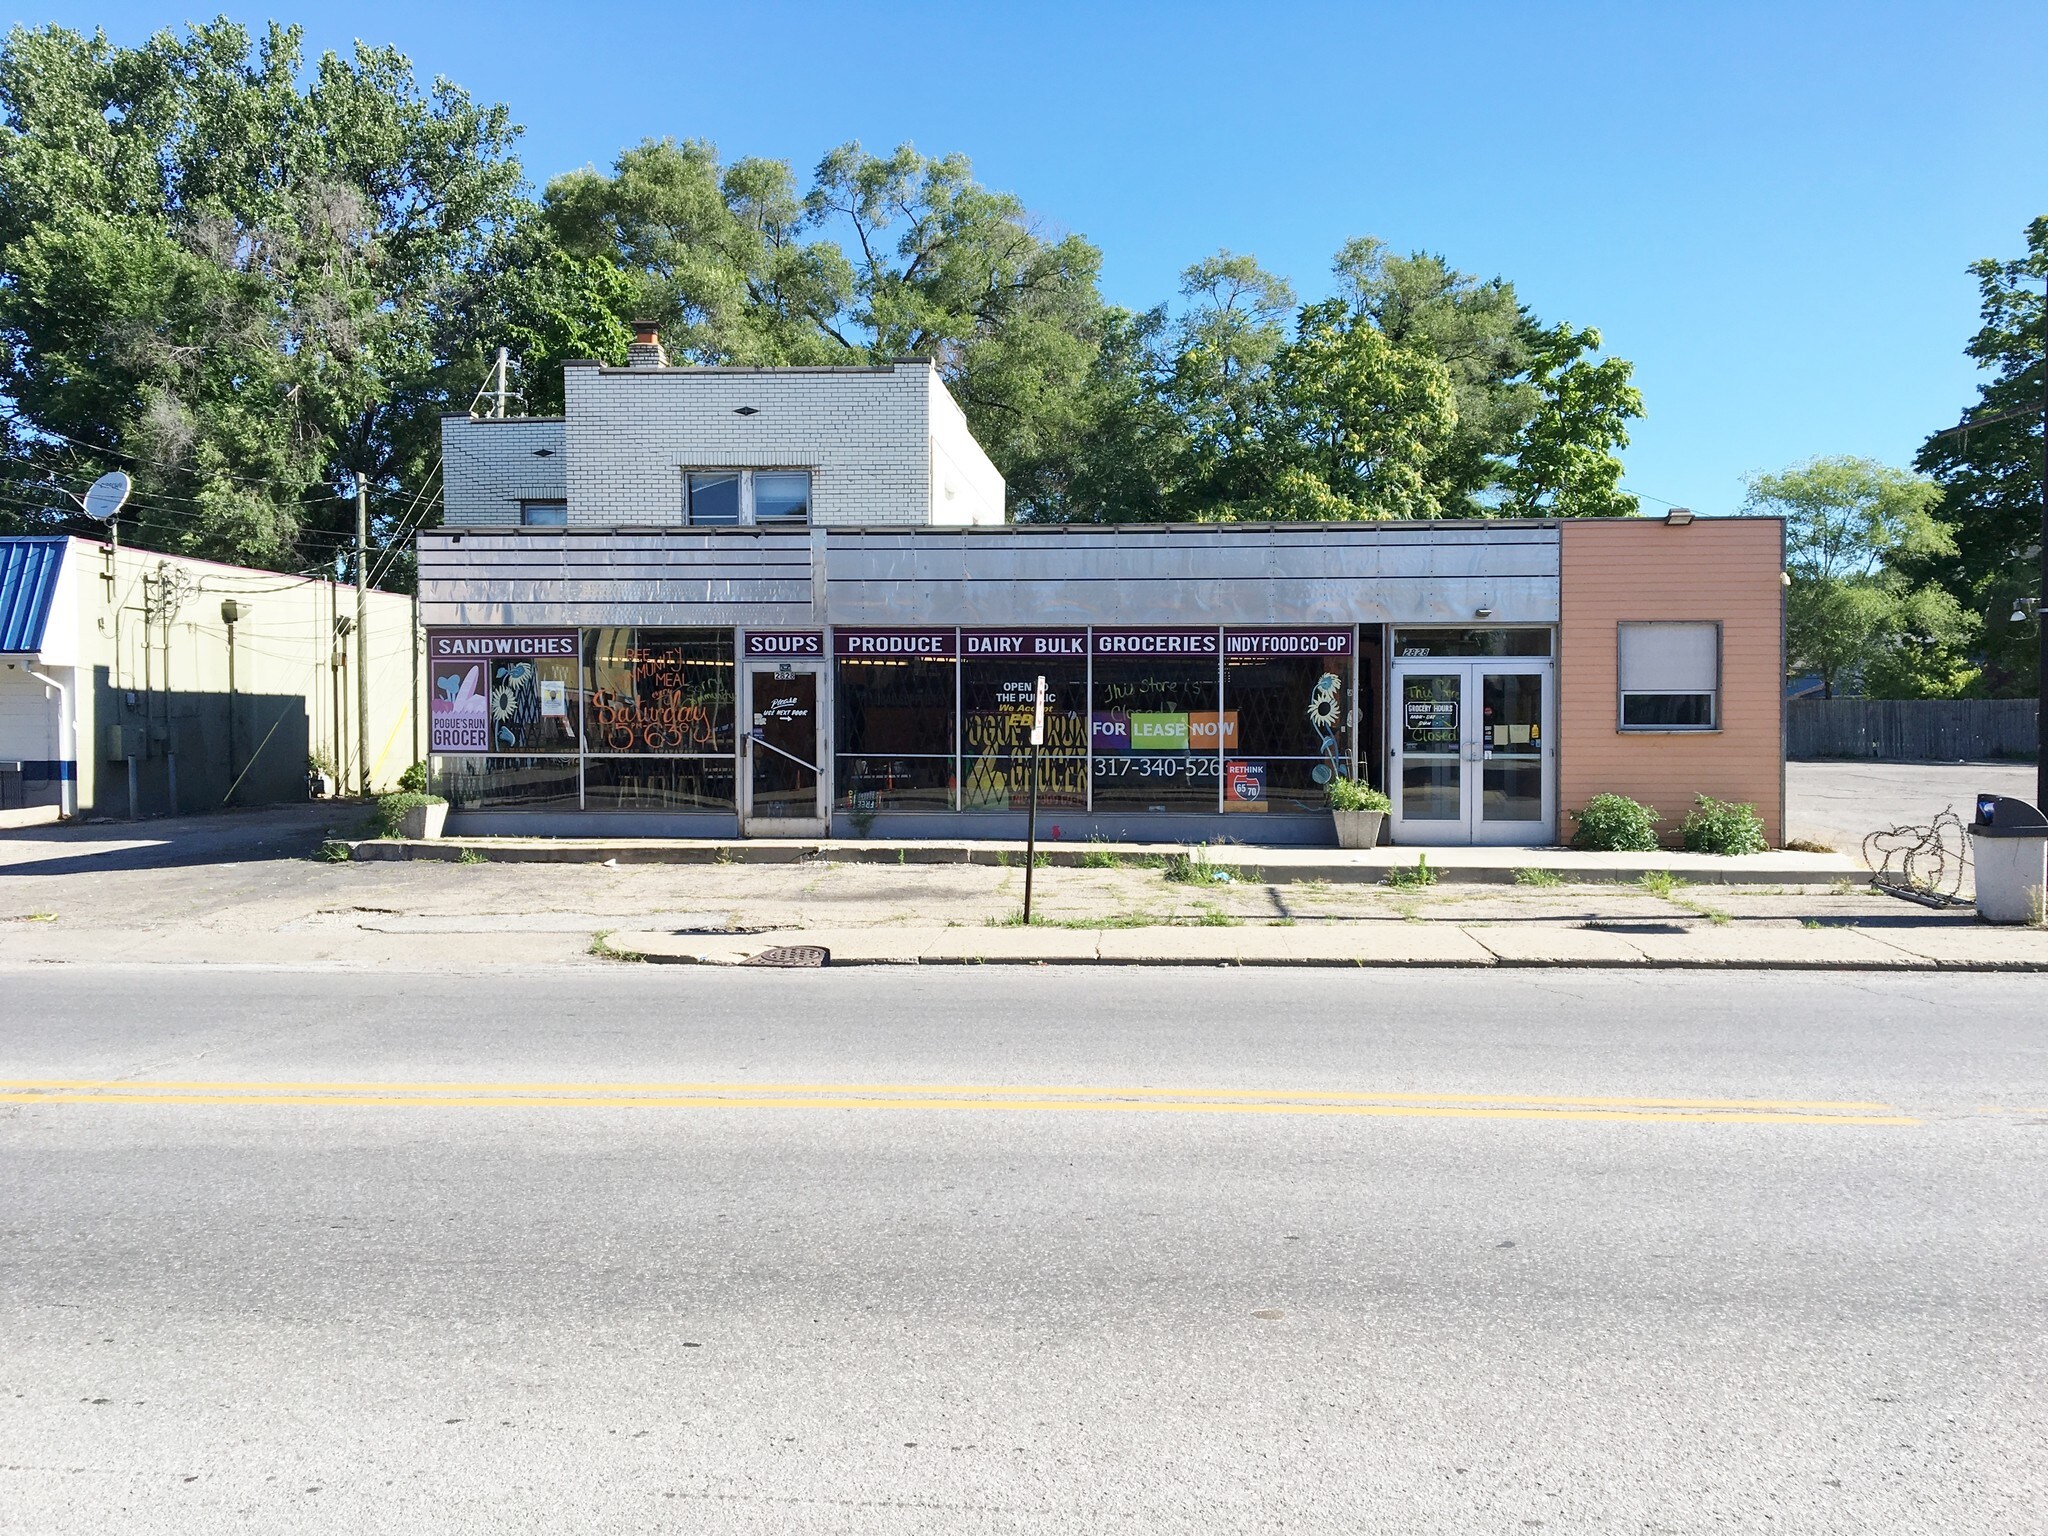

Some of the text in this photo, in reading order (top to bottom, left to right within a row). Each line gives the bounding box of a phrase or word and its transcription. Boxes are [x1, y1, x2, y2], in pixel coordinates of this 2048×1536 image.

[438, 638, 573, 654] SANDWICHES
[751, 636, 818, 652] SOUPS
[848, 637, 943, 652] PRODUCE
[968, 637, 1084, 653] DAIRY BULK
[1099, 636, 1216, 652] GROCERIES
[1227, 636, 1346, 652] INDY FOOD CO-OP
[1404, 648, 1429, 656] 2828
[655, 672, 690, 687] MEAL
[1003, 682, 1032, 691] OPEN
[996, 693, 1016, 702] THE
[999, 704, 1014, 712] We
[1433, 704, 1453, 712] HOURS
[434, 718, 485, 729] POGUE'S RUN
[1093, 722, 1234, 736] FOR LEASE NOW
[434, 730, 487, 746] GROCER
[1229, 766, 1264, 774] RETHINK
[1237, 784, 1247, 793] 65
[1247, 787, 1257, 796] 70
